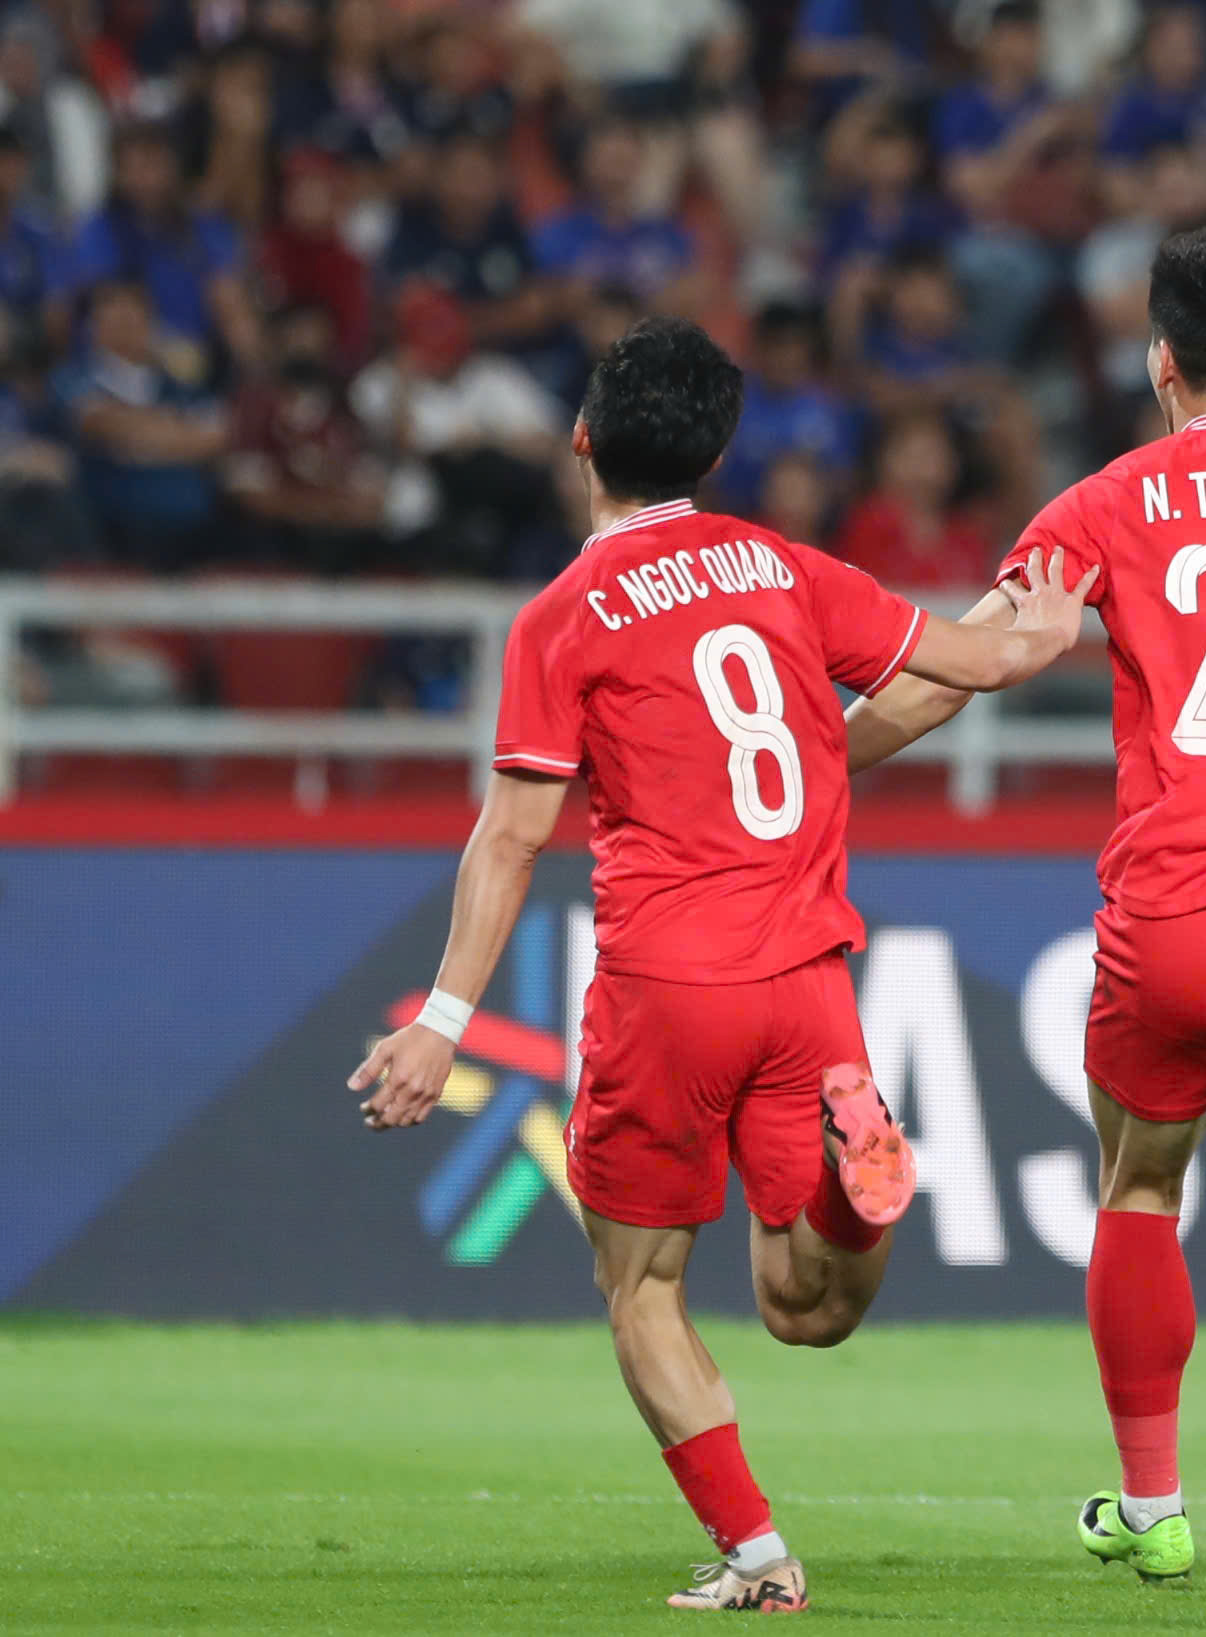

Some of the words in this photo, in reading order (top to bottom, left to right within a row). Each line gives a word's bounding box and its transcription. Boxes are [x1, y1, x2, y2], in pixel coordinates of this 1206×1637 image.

[1142, 472, 1183, 524] N.
[587, 590, 632, 631] C.
[616, 550, 710, 620] NGOC
[692, 623, 805, 841] 8
